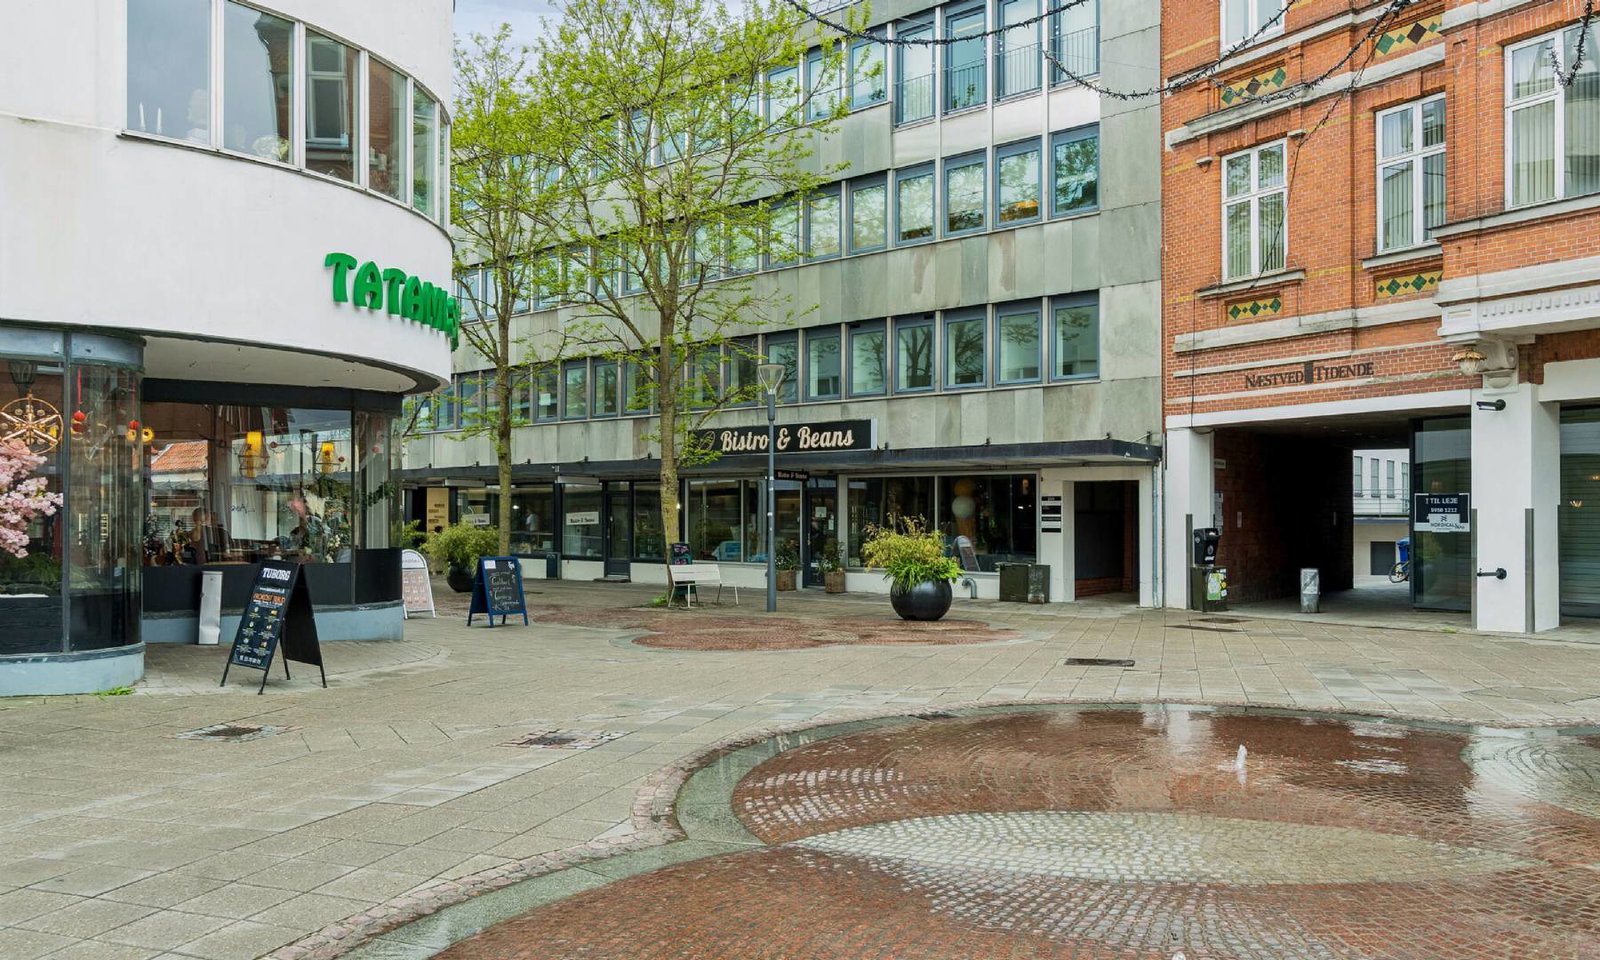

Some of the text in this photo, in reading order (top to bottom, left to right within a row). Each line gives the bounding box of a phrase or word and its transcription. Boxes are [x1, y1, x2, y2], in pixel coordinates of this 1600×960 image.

[1314, 362, 1374, 381] TIDENDE
[720, 426, 854, 451] Bistro & Beans
[262, 567, 291, 581] TUBORG
